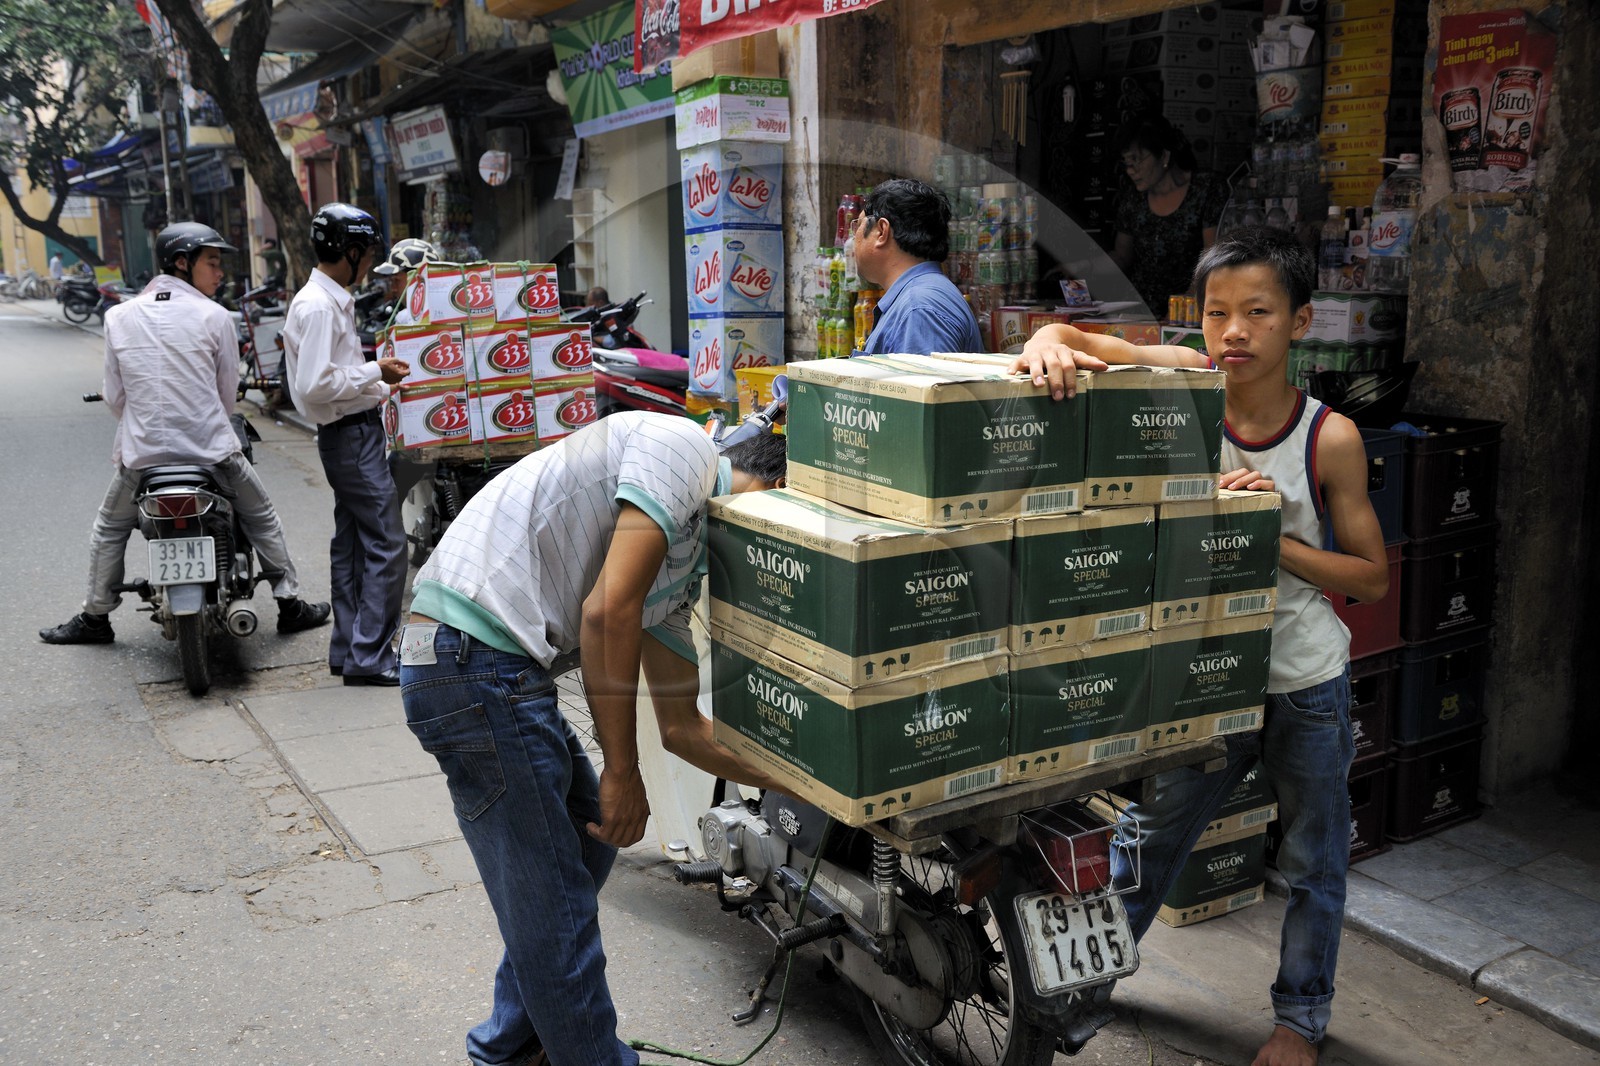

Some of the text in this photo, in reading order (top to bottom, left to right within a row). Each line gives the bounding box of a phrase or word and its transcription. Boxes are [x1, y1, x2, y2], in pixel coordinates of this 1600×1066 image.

[621, 34, 634, 58] CU
[1469, 33, 1494, 47] ngay
[1486, 45, 1496, 64] 3
[1496, 93, 1534, 115] Birdy
[1445, 106, 1477, 125] Birdy
[1487, 154, 1521, 163] ROBUSTA
[467, 285, 492, 306] 333
[531, 286, 558, 306] 333
[435, 345, 463, 368] 333
[502, 345, 529, 366] 333
[565, 343, 591, 364] 333
[797, 385, 806, 393] BIA
[440, 405, 468, 428] 333
[506, 403, 534, 425] 333
[570, 401, 596, 422] 333
[833, 427, 869, 449] SPECIAL
[1140, 430, 1177, 440] SPECIAL
[993, 440, 1035, 454] SPECIAL
[159, 541, 203, 560] 33-N1
[755, 536, 795, 555] PREMIUM QUALITY
[1208, 551, 1241, 564] SPECIAL
[160, 562, 205, 581] 2323
[1073, 568, 1110, 583] SPECIAL
[756, 570, 794, 598] SPECIAL
[915, 591, 959, 608] SPECIAL
[788, 620, 817, 638] INGREDIENTS
[756, 666, 796, 691] PREMIUM QUALITY
[1197, 672, 1230, 685] SPECIAL
[1067, 697, 1105, 712] SPECIAL
[756, 700, 793, 733] SPECIAL
[915, 729, 958, 748] SPECIAL
[890, 764, 912, 774] BREWED
[926, 754, 948, 765] NATURAL
[949, 745, 981, 758] INGREDIENTS
[1207, 856, 1244, 873] SAIGON
[1049, 930, 1123, 981] 1485
